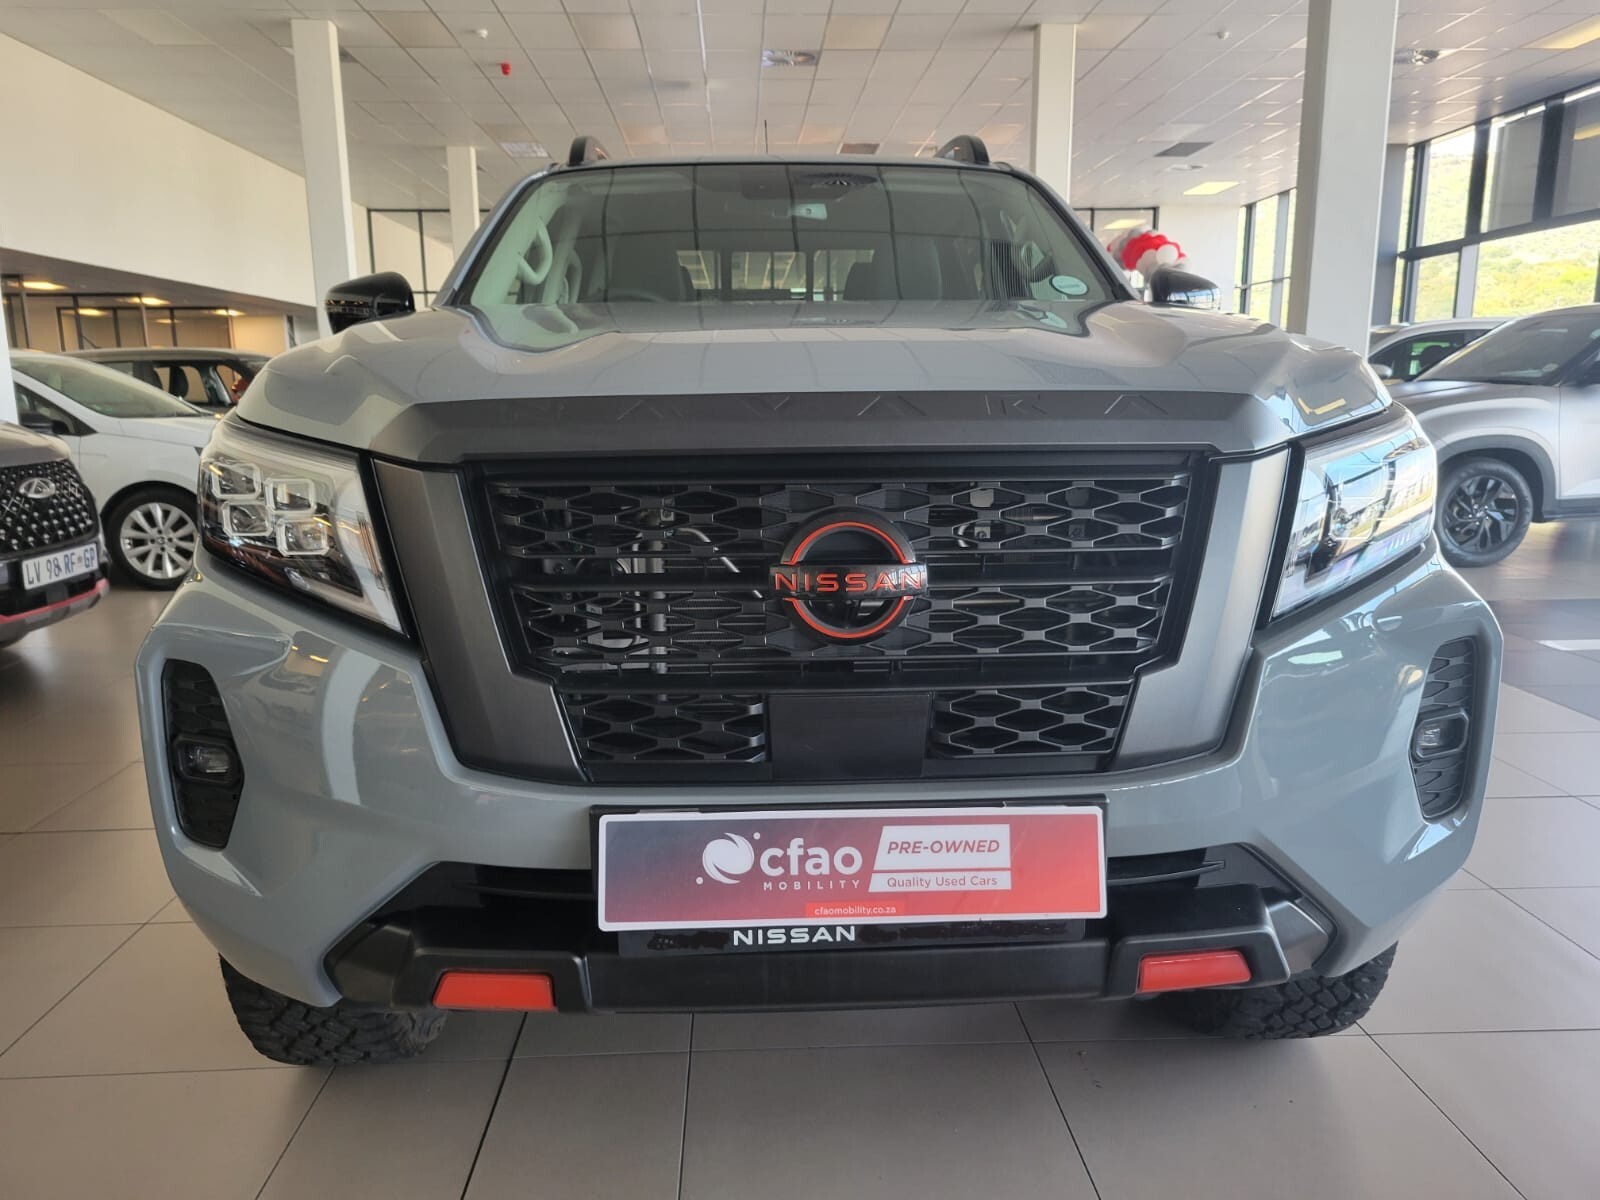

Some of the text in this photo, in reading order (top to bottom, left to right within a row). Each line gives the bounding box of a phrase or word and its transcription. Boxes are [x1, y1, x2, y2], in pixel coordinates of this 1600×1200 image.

[499, 394, 1169, 422] NAVARA
[26, 547, 96, 585] LV 98 RF GP
[774, 572, 922, 592] NISSAN
[887, 839, 1000, 854] PRE-OWNED
[759, 837, 863, 877] cfao
[763, 879, 860, 891] MOBILITY
[887, 875, 998, 888] Quality Used Cars
[814, 903, 897, 916] cfaomobility.co.za
[733, 926, 855, 946] NISSAN
